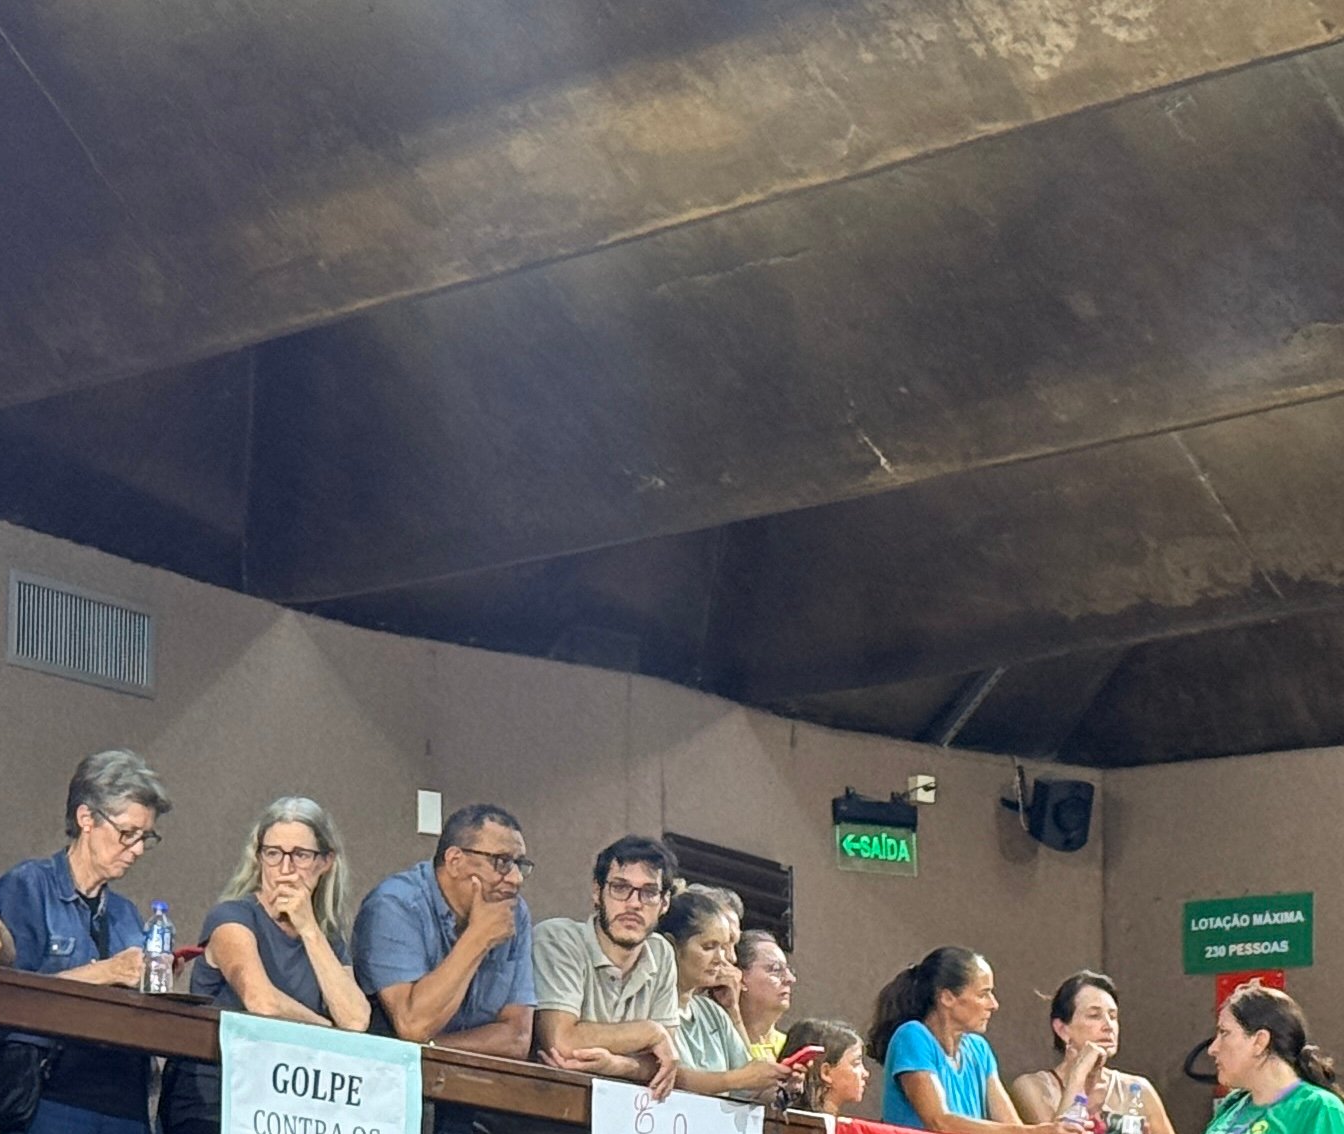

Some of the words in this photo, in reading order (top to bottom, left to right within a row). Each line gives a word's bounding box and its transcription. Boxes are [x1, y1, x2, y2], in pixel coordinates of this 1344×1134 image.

[860, 832, 911, 862] SAÍDA
[1191, 912, 1250, 931] LOTAÇÃO
[1253, 909, 1305, 926] MÁXIMA
[1204, 945, 1226, 958] 230
[1228, 940, 1289, 957] PESSOAS
[272, 1062, 364, 1107] GOLPE
